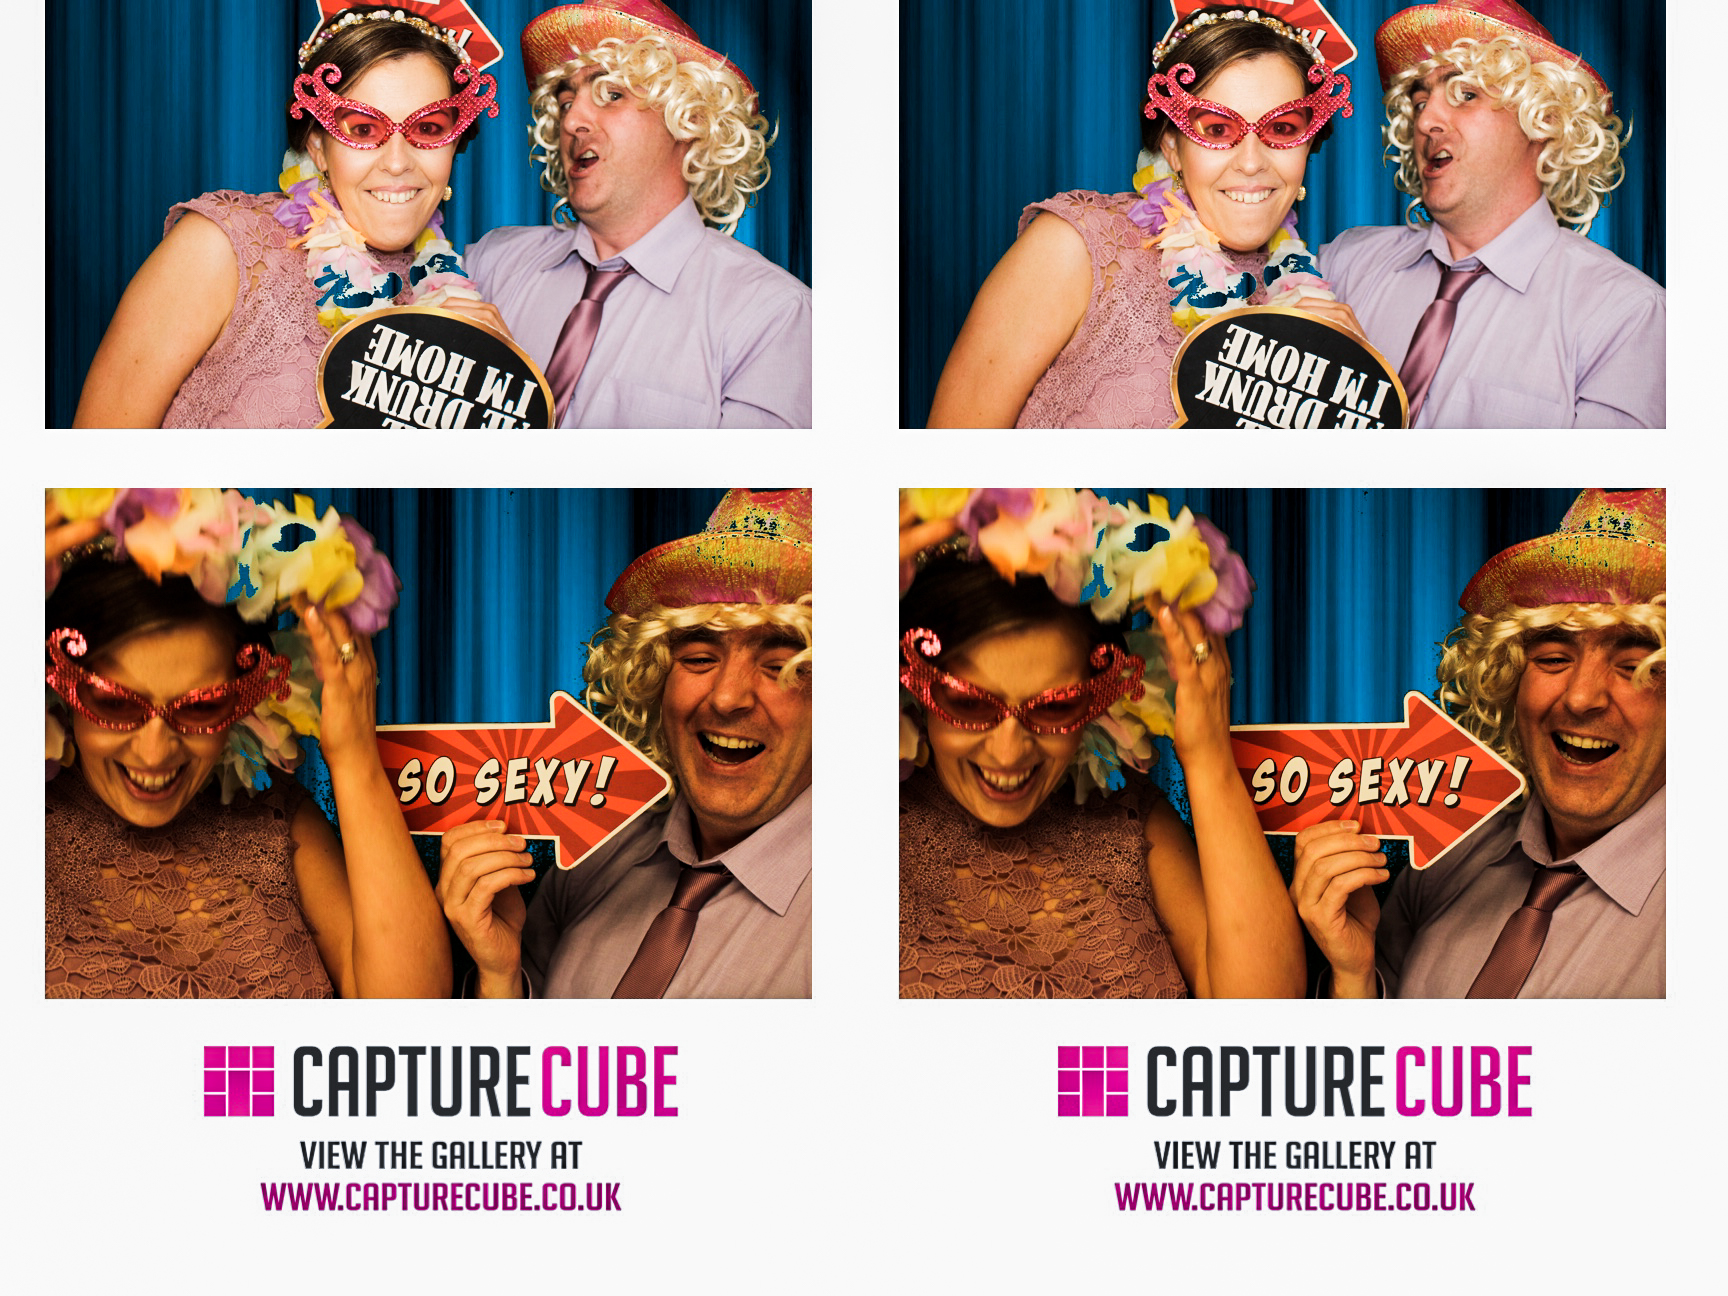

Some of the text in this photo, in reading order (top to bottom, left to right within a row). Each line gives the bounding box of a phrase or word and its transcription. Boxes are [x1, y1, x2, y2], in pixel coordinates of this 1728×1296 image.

[340, 360, 475, 429] DRUNK
[363, 323, 538, 419] I'M HOME
[1194, 360, 1329, 429] DRUNK
[1217, 323, 1392, 419] I'M HOME
[397, 755, 619, 808] SO SEXY!
[1251, 755, 1473, 808] SO SEXY!
